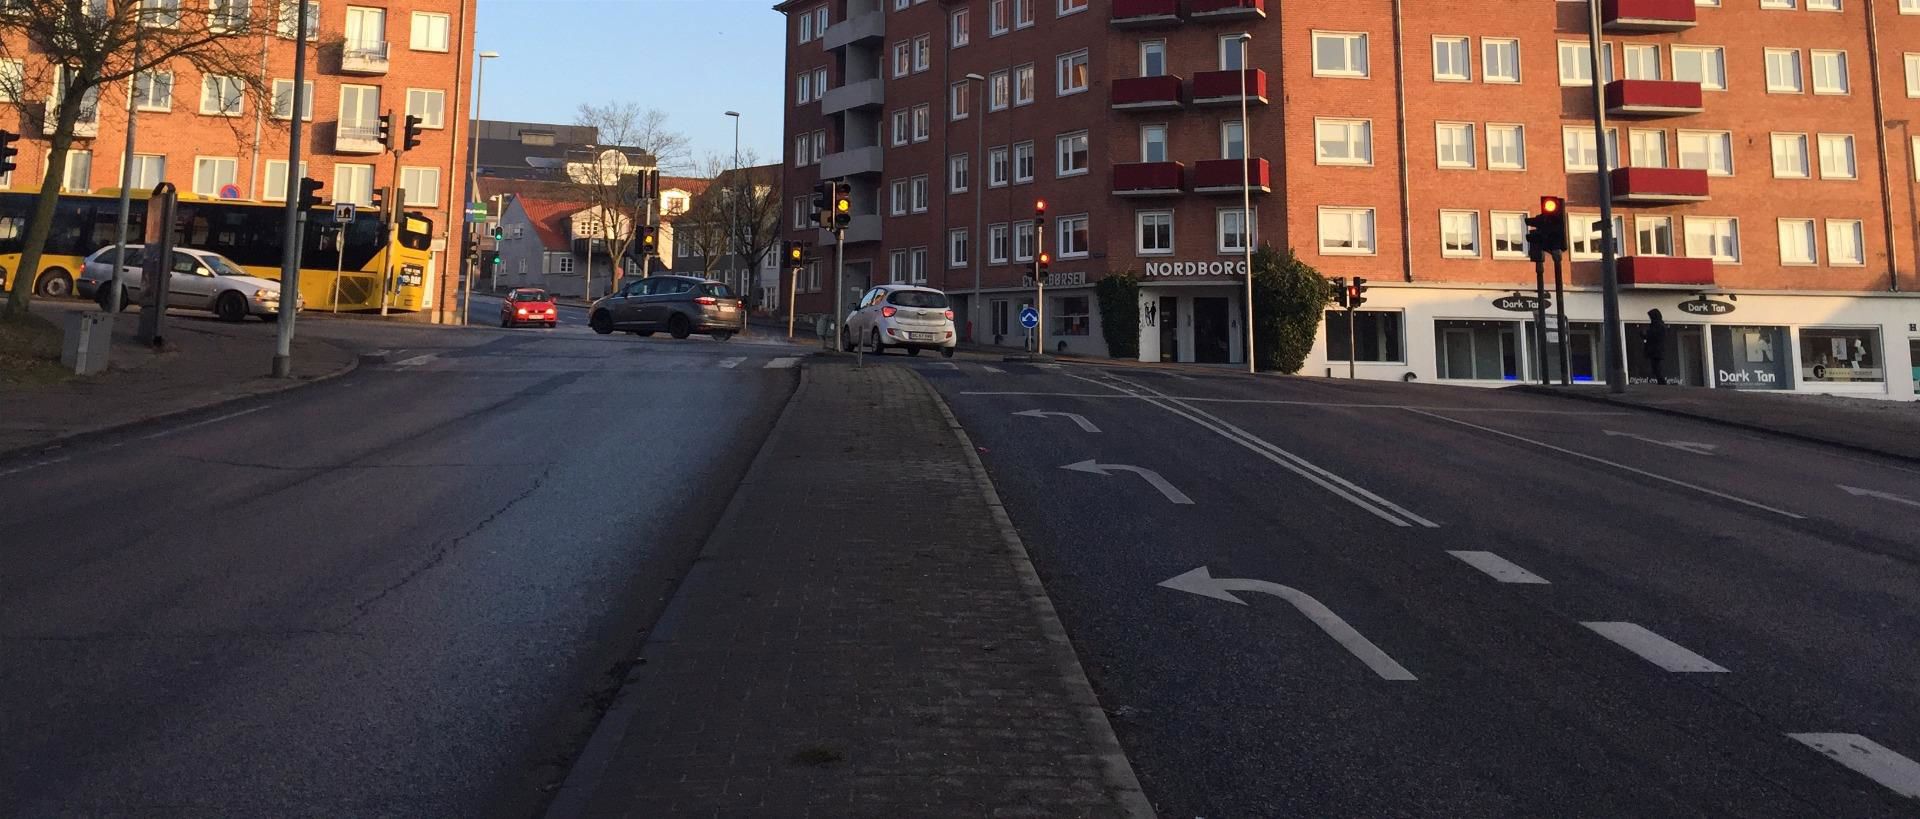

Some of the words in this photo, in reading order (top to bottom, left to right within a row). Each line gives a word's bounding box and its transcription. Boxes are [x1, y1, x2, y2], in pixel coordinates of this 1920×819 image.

[1145, 261, 1246, 276] NORDBORG
[1502, 300, 1523, 309] Dark
[1688, 303, 1708, 312] Dark
[1711, 303, 1726, 312] Tan
[1719, 369, 1750, 382] Dark
[1754, 370, 1776, 382] Tan
